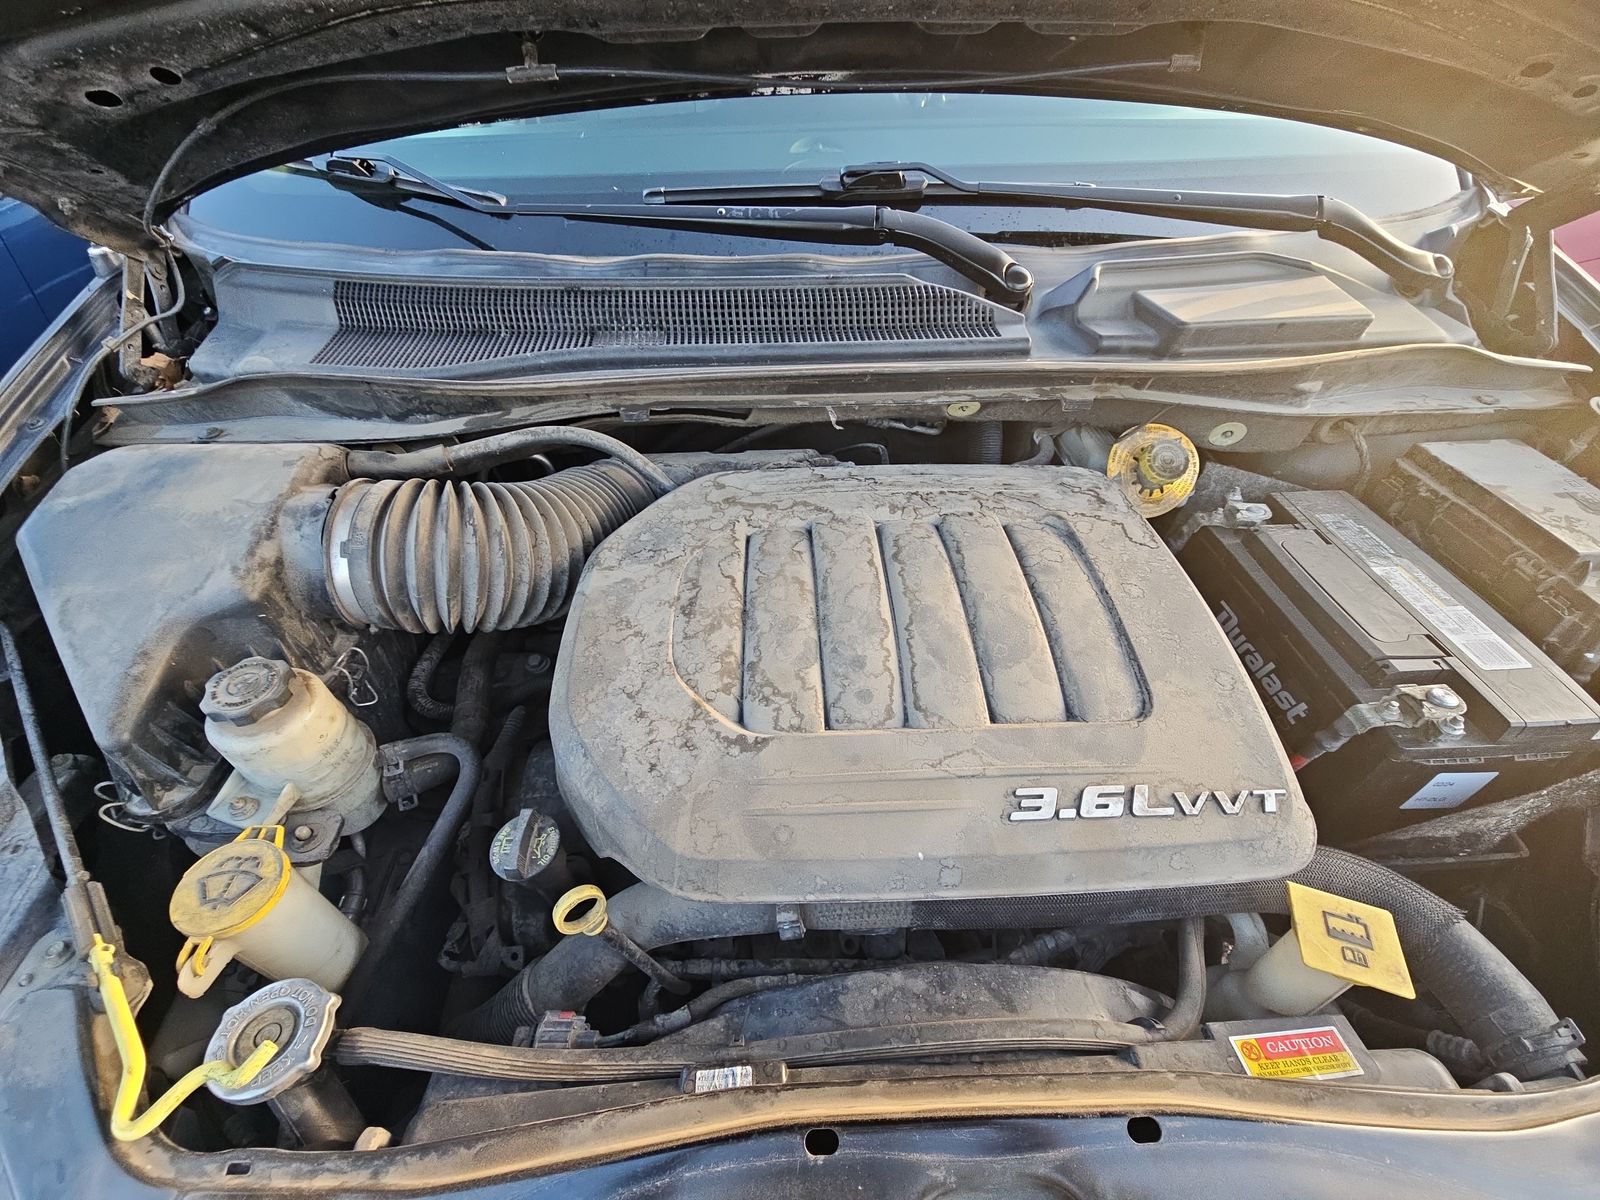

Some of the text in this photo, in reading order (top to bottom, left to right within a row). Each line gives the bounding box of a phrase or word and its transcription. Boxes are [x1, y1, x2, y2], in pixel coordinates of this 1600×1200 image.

[1216, 599, 1308, 725] Duralast
[1008, 784, 1175, 821] 3.6L
[537, 854, 550, 866] OIL
[249, 986, 291, 1009] OPEN
[291, 986, 316, 1005] NOT
[303, 1006, 319, 1028] DO
[1266, 1035, 1335, 1054] CAUTION
[1258, 1054, 1340, 1071] KEEP HANDS CLEAR
